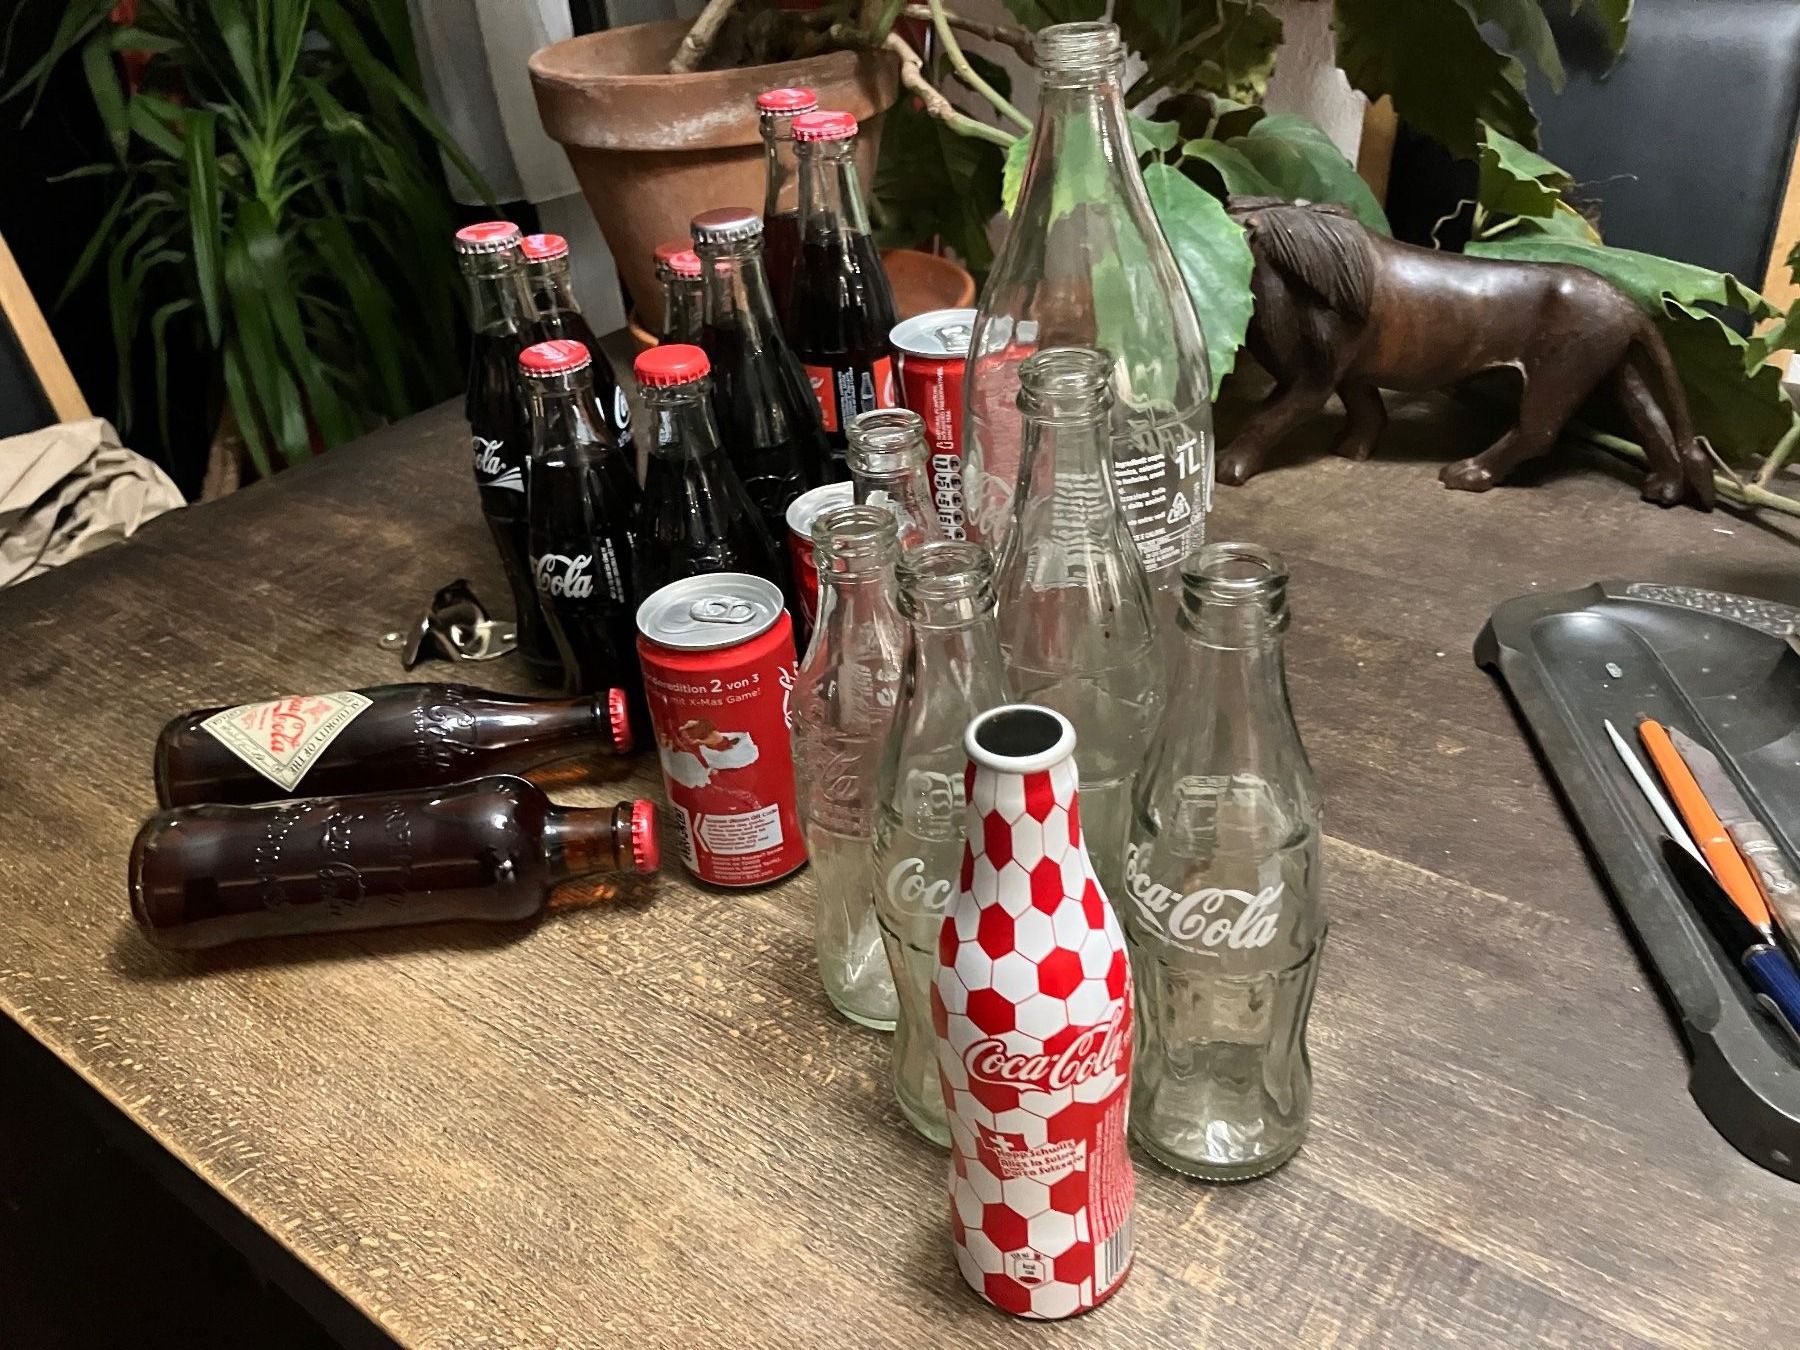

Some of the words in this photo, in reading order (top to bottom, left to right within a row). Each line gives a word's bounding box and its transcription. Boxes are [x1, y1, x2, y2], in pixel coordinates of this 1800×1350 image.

[1175, 446, 1201, 480] 1L
[709, 678, 724, 693] 2
[726, 677, 750, 691] von
[752, 673, 760, 684] 3
[689, 698, 723, 706] X-Mas
[304, 743, 317, 758] OF
[964, 1004, 1124, 1090] Coca-Cola
